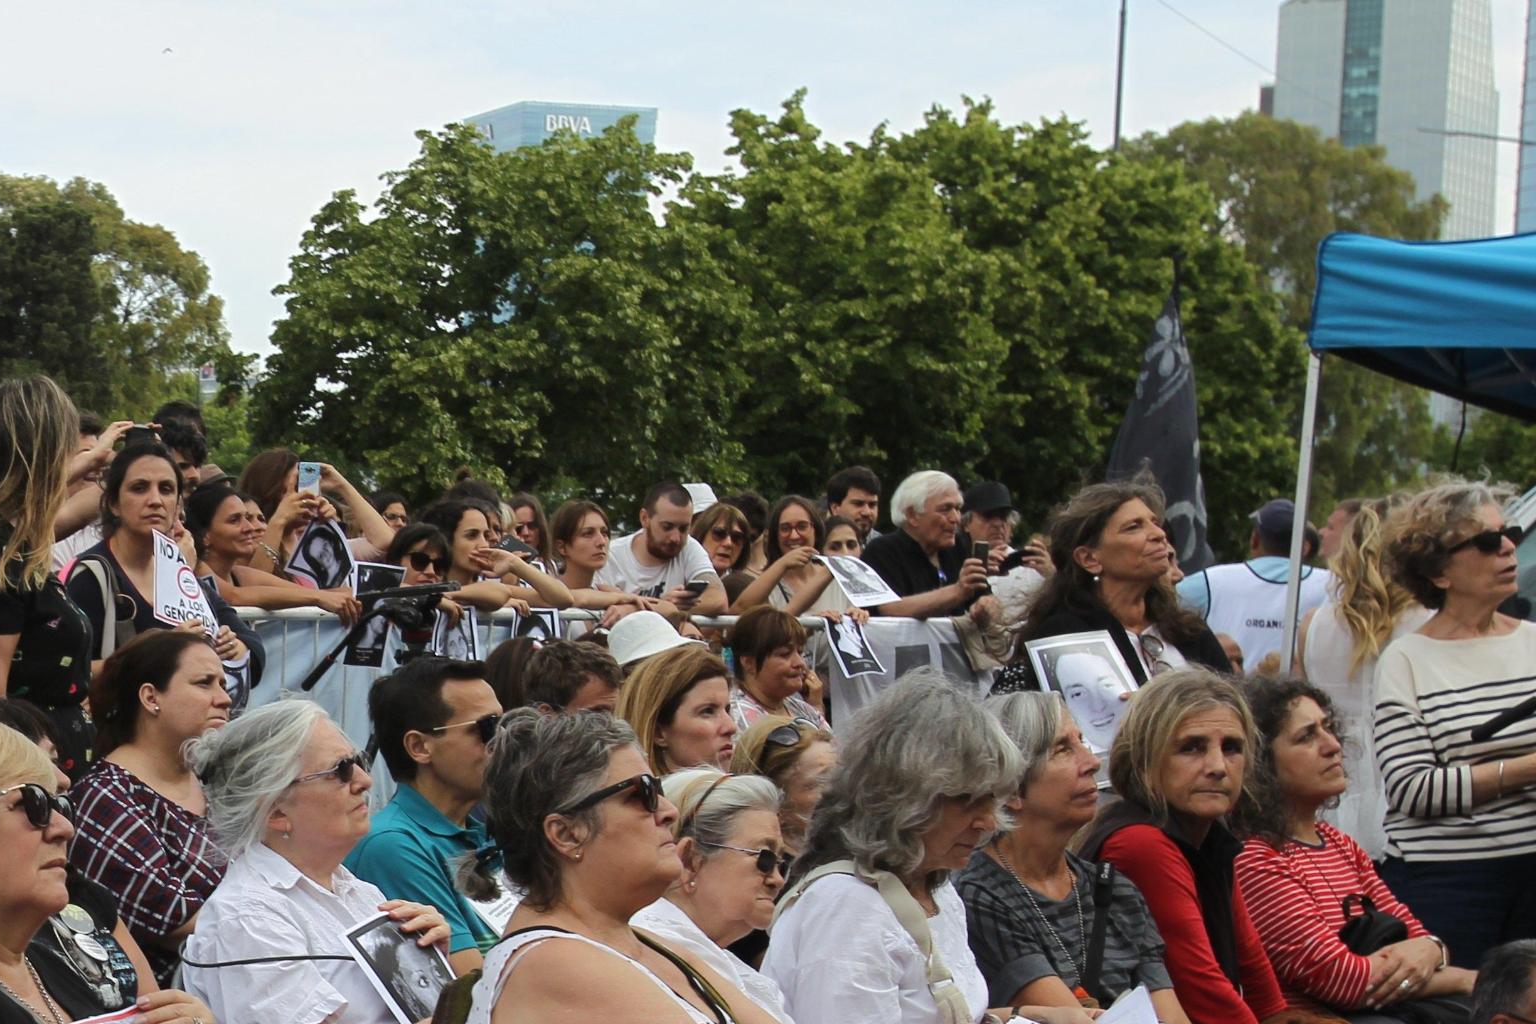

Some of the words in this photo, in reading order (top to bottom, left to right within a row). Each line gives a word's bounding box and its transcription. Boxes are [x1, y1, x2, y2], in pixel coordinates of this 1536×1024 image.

[546, 114, 592, 134] BBVA
[159, 539, 174, 559] NO
[164, 604, 215, 634] GENOCID
[1245, 618, 1284, 630] ORGANI
